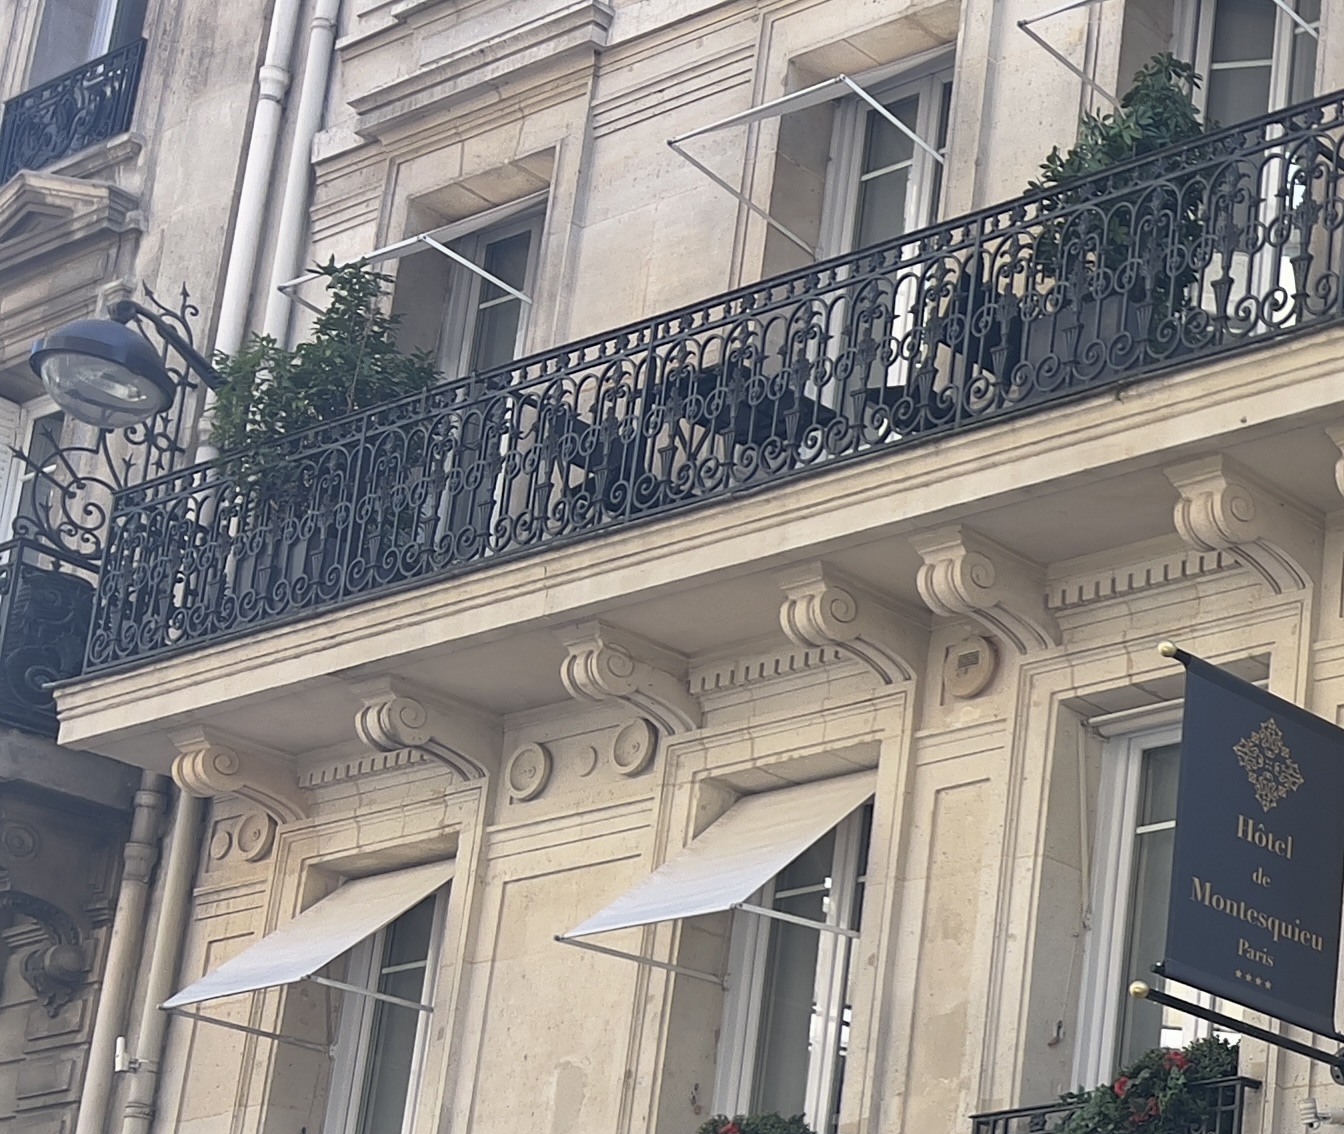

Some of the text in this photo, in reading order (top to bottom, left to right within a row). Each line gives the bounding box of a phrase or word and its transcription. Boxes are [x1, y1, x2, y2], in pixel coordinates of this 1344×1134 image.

[1235, 814, 1294, 860] Hôtel
[1252, 867, 1271, 888] de
[1190, 876, 1325, 953] Montesquieu
[1237, 938, 1275, 967] Paris
